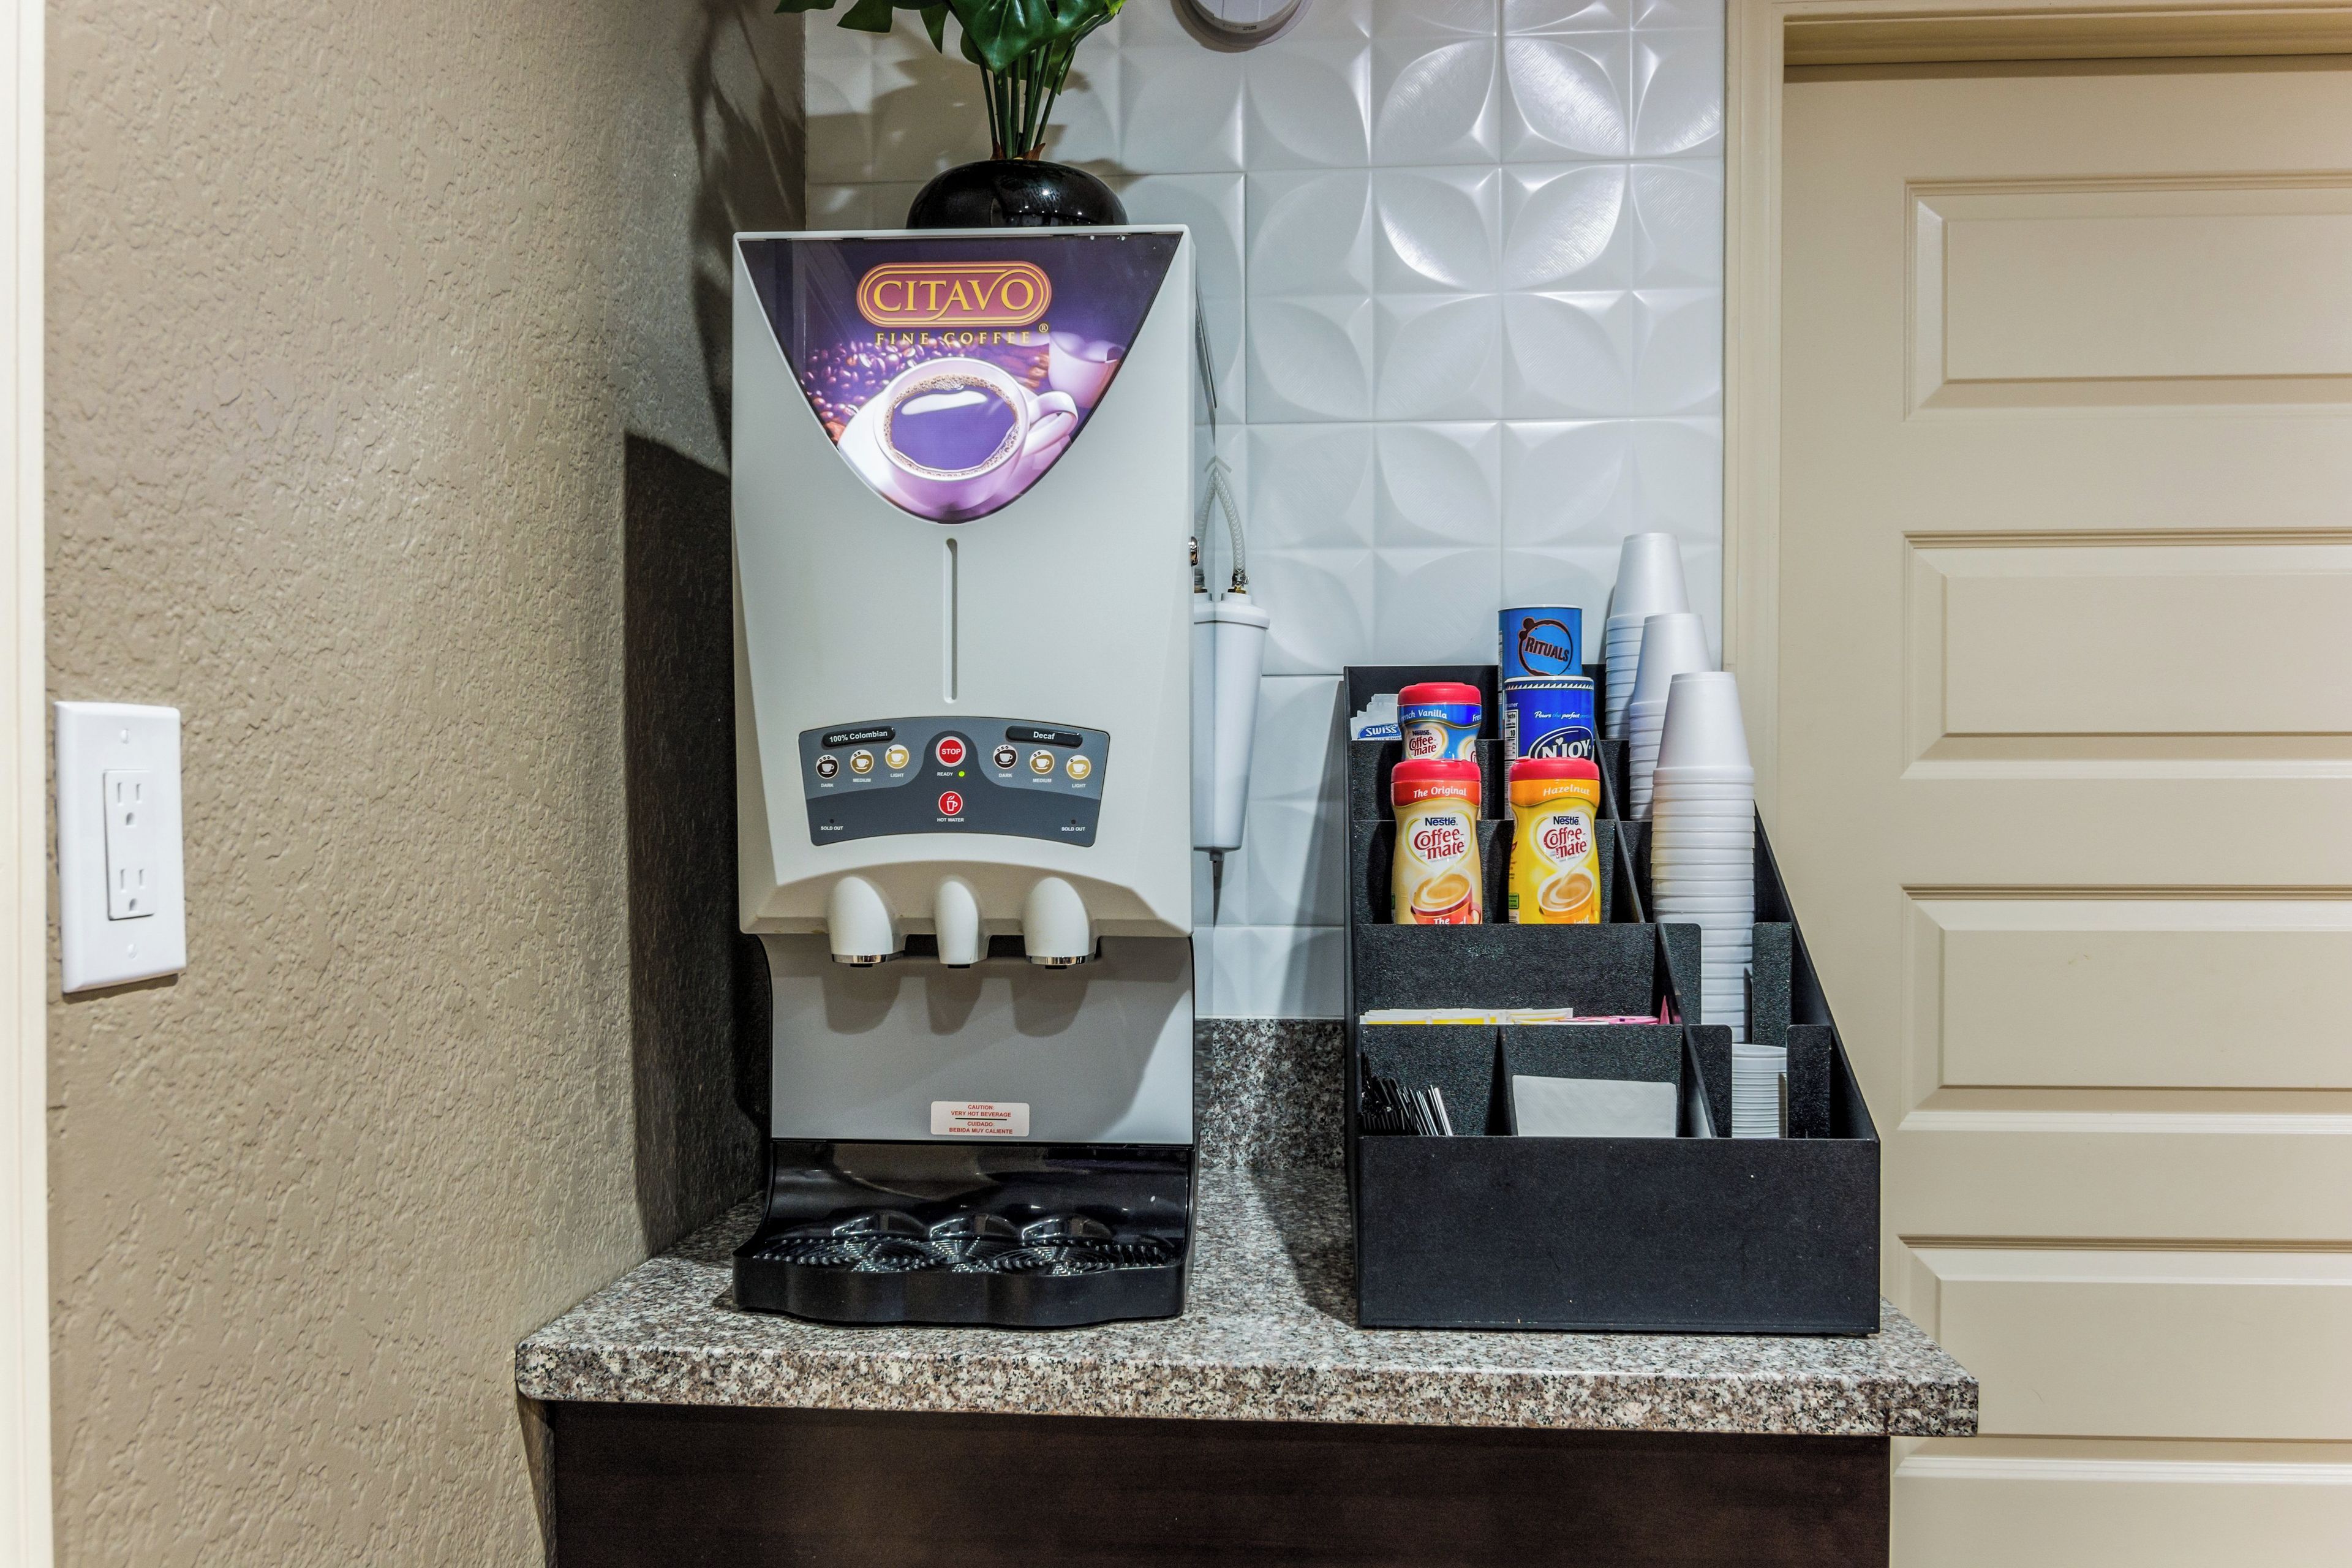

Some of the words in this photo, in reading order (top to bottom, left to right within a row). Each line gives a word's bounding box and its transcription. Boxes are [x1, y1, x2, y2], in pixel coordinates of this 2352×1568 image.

[873, 279, 1034, 312] CITAVO
[876, 332, 929, 346] FINE
[943, 331, 1030, 346] COFFEE
[1525, 636, 1569, 662] RITUALS
[1418, 709, 1447, 720] Vanilla
[829, 734, 848, 743] 100%
[850, 730, 888, 741] Colombian
[1033, 731, 1055, 740] Decaf
[1365, 726, 1397, 737] SWISS
[1414, 744, 1437, 756] mate
[1413, 789, 1428, 799] The
[1431, 786, 1467, 797] Original
[1543, 783, 1591, 797] Hazelnut
[1427, 840, 1464, 860] mate
[1555, 839, 1587, 859] mate
